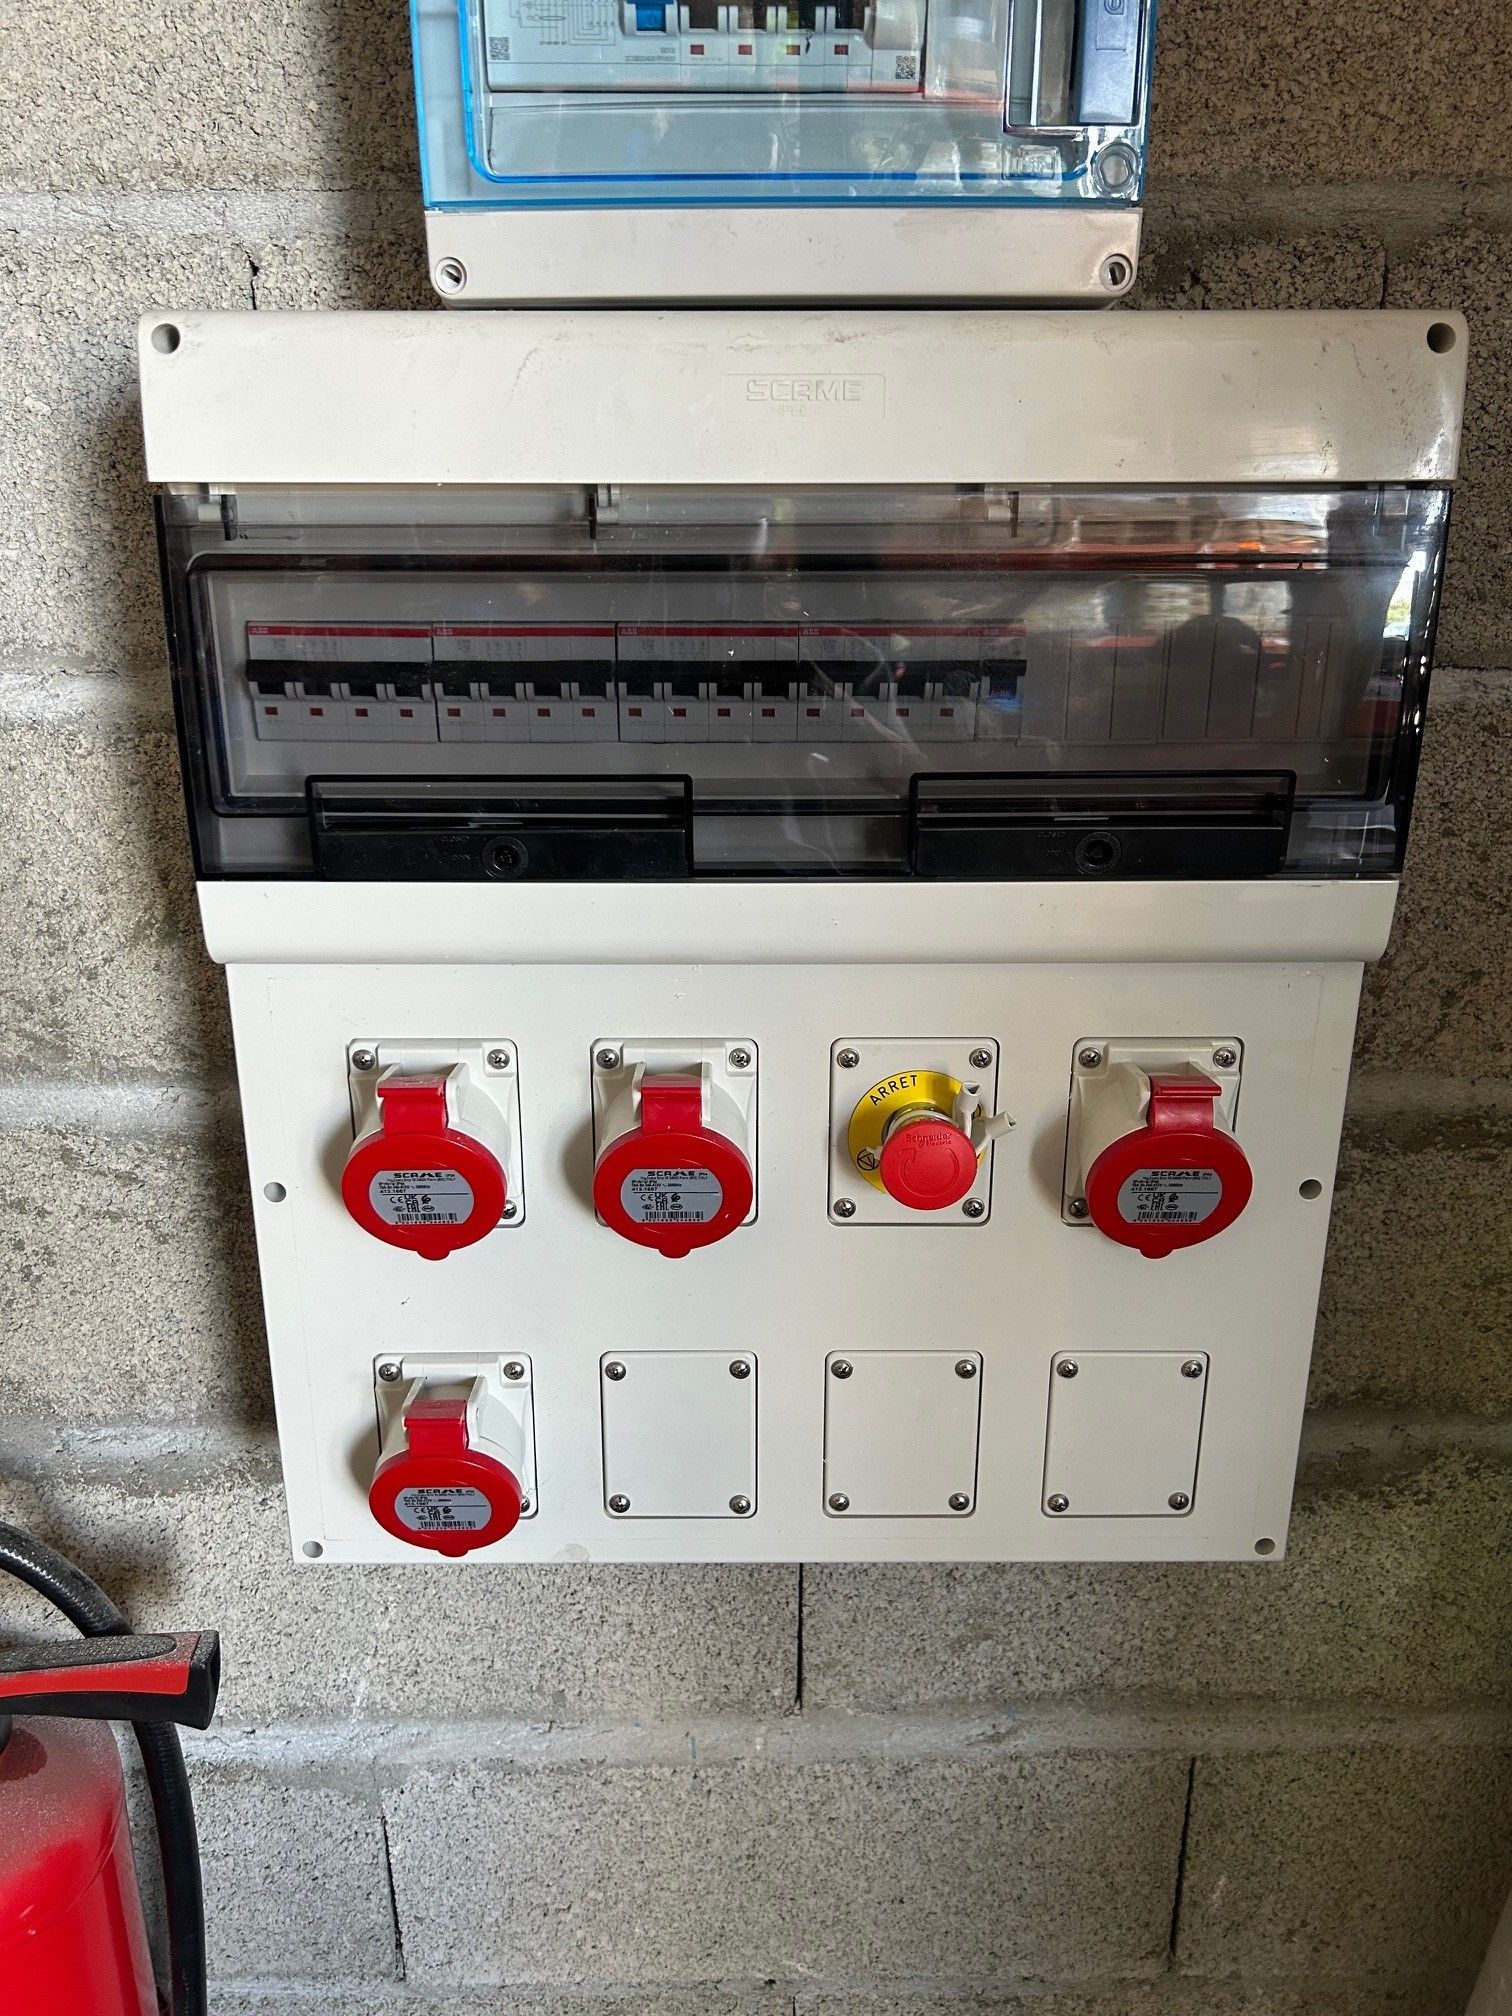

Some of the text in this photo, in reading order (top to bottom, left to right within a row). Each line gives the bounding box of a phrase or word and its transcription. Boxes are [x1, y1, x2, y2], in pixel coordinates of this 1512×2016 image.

[747, 379, 861, 401] SCAME
[869, 1074, 918, 1106] ARRET
[905, 1132, 952, 1143] Schneider
